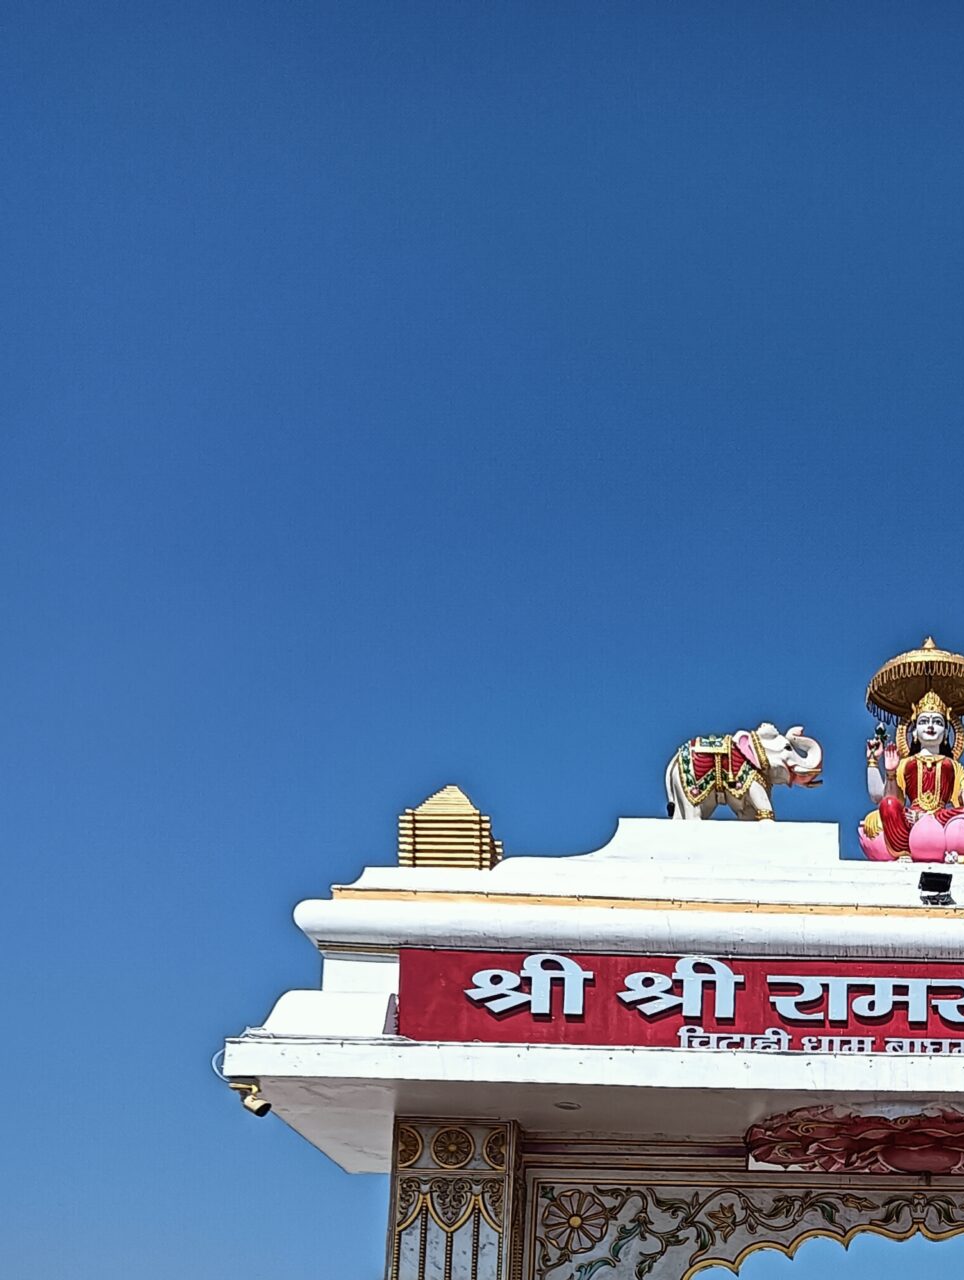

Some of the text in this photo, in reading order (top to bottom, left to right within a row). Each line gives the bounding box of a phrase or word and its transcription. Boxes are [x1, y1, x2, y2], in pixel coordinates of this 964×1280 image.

[464, 954, 593, 1016] श्री
[616, 957, 744, 1018] श्री
[801, 1036, 875, 1053] धाम
